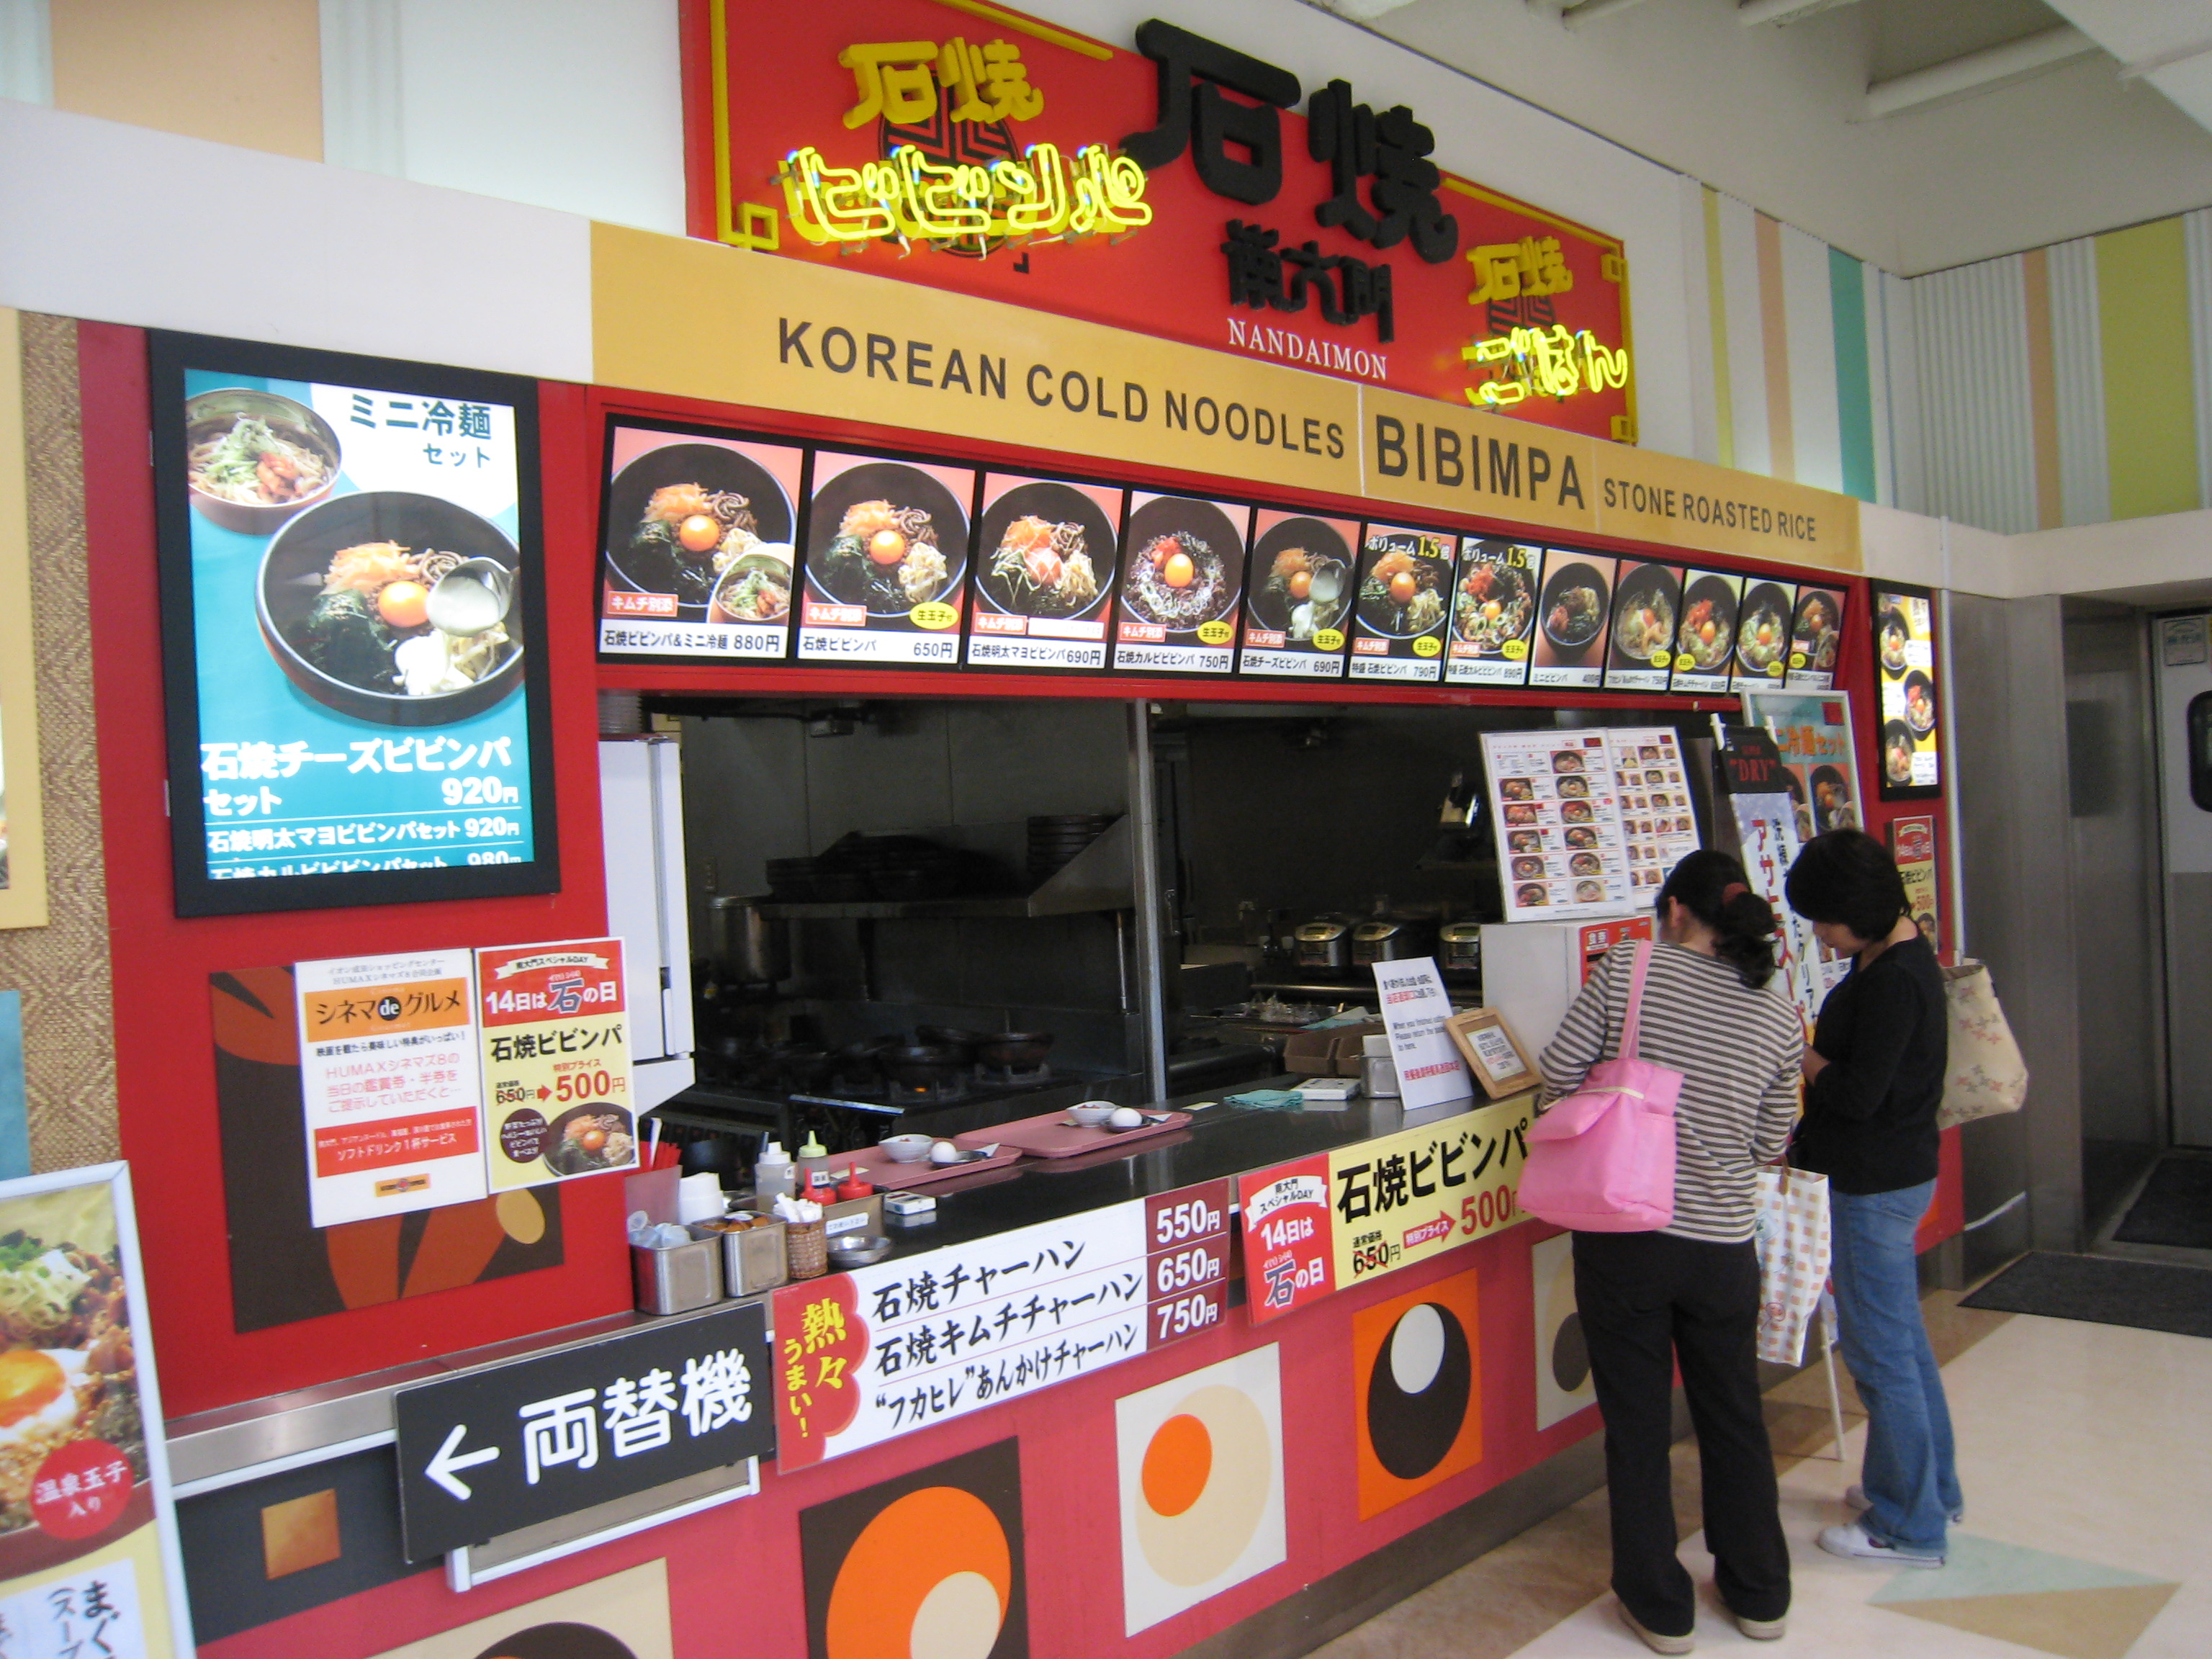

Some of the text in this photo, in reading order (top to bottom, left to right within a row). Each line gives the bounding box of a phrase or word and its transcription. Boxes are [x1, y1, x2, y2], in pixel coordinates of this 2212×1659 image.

[838, 37, 1044, 129] 石焼
[1120, 18, 1458, 264] 石焼
[777, 143, 1152, 241] ビビンパ
[1465, 236, 1573, 304] 石焼
[1227, 318, 1388, 381] NANDAIMON
[1461, 325, 1627, 405] ごはん
[779, 317, 1344, 460] KOREAN COLD NOODLES
[349, 393, 492, 440] ミニ冷麺
[422, 443, 490, 469] セット
[1376, 414, 1586, 510] BIBIMPA
[1604, 477, 1816, 542] STONE ROASTED RICE
[734, 634, 780, 652] 880円
[803, 636, 953, 658] 石焼ビビンパ 650円
[972, 644, 1101, 665] 石焼明太マヨビビンパ 690円
[1117, 650, 1229, 669] 石焼カルビビビンパ 750円
[1313, 660, 1340, 674] 690円
[200, 736, 512, 781] 石焼チーズビビンパ
[203, 775, 518, 816] セット 920円
[207, 817, 519, 853] 石焼明太マヨビビンパセット 920円
[315, 989, 461, 1026] シネマdeグルメ
[490, 1024, 624, 1063] 石焼ビビンパ
[557, 1070, 626, 1102] 500円
[1336, 1118, 1529, 1223] 石焼ビビンパ
[1260, 1189, 1314, 1214] スペシャルDAY
[1261, 1216, 1314, 1251] 14日は
[872, 1198, 1221, 1323] 石焼チャーハン 550円
[1264, 1256, 1324, 1308] 石の日
[873, 1247, 1220, 1377] 石焼キムチチャーハン 650円
[1157, 1294, 1218, 1341] 750円
[801, 1297, 848, 1390] 熱々
[518, 1348, 753, 1485] 両替機
[36, 1460, 128, 1505] 温泉玉子
